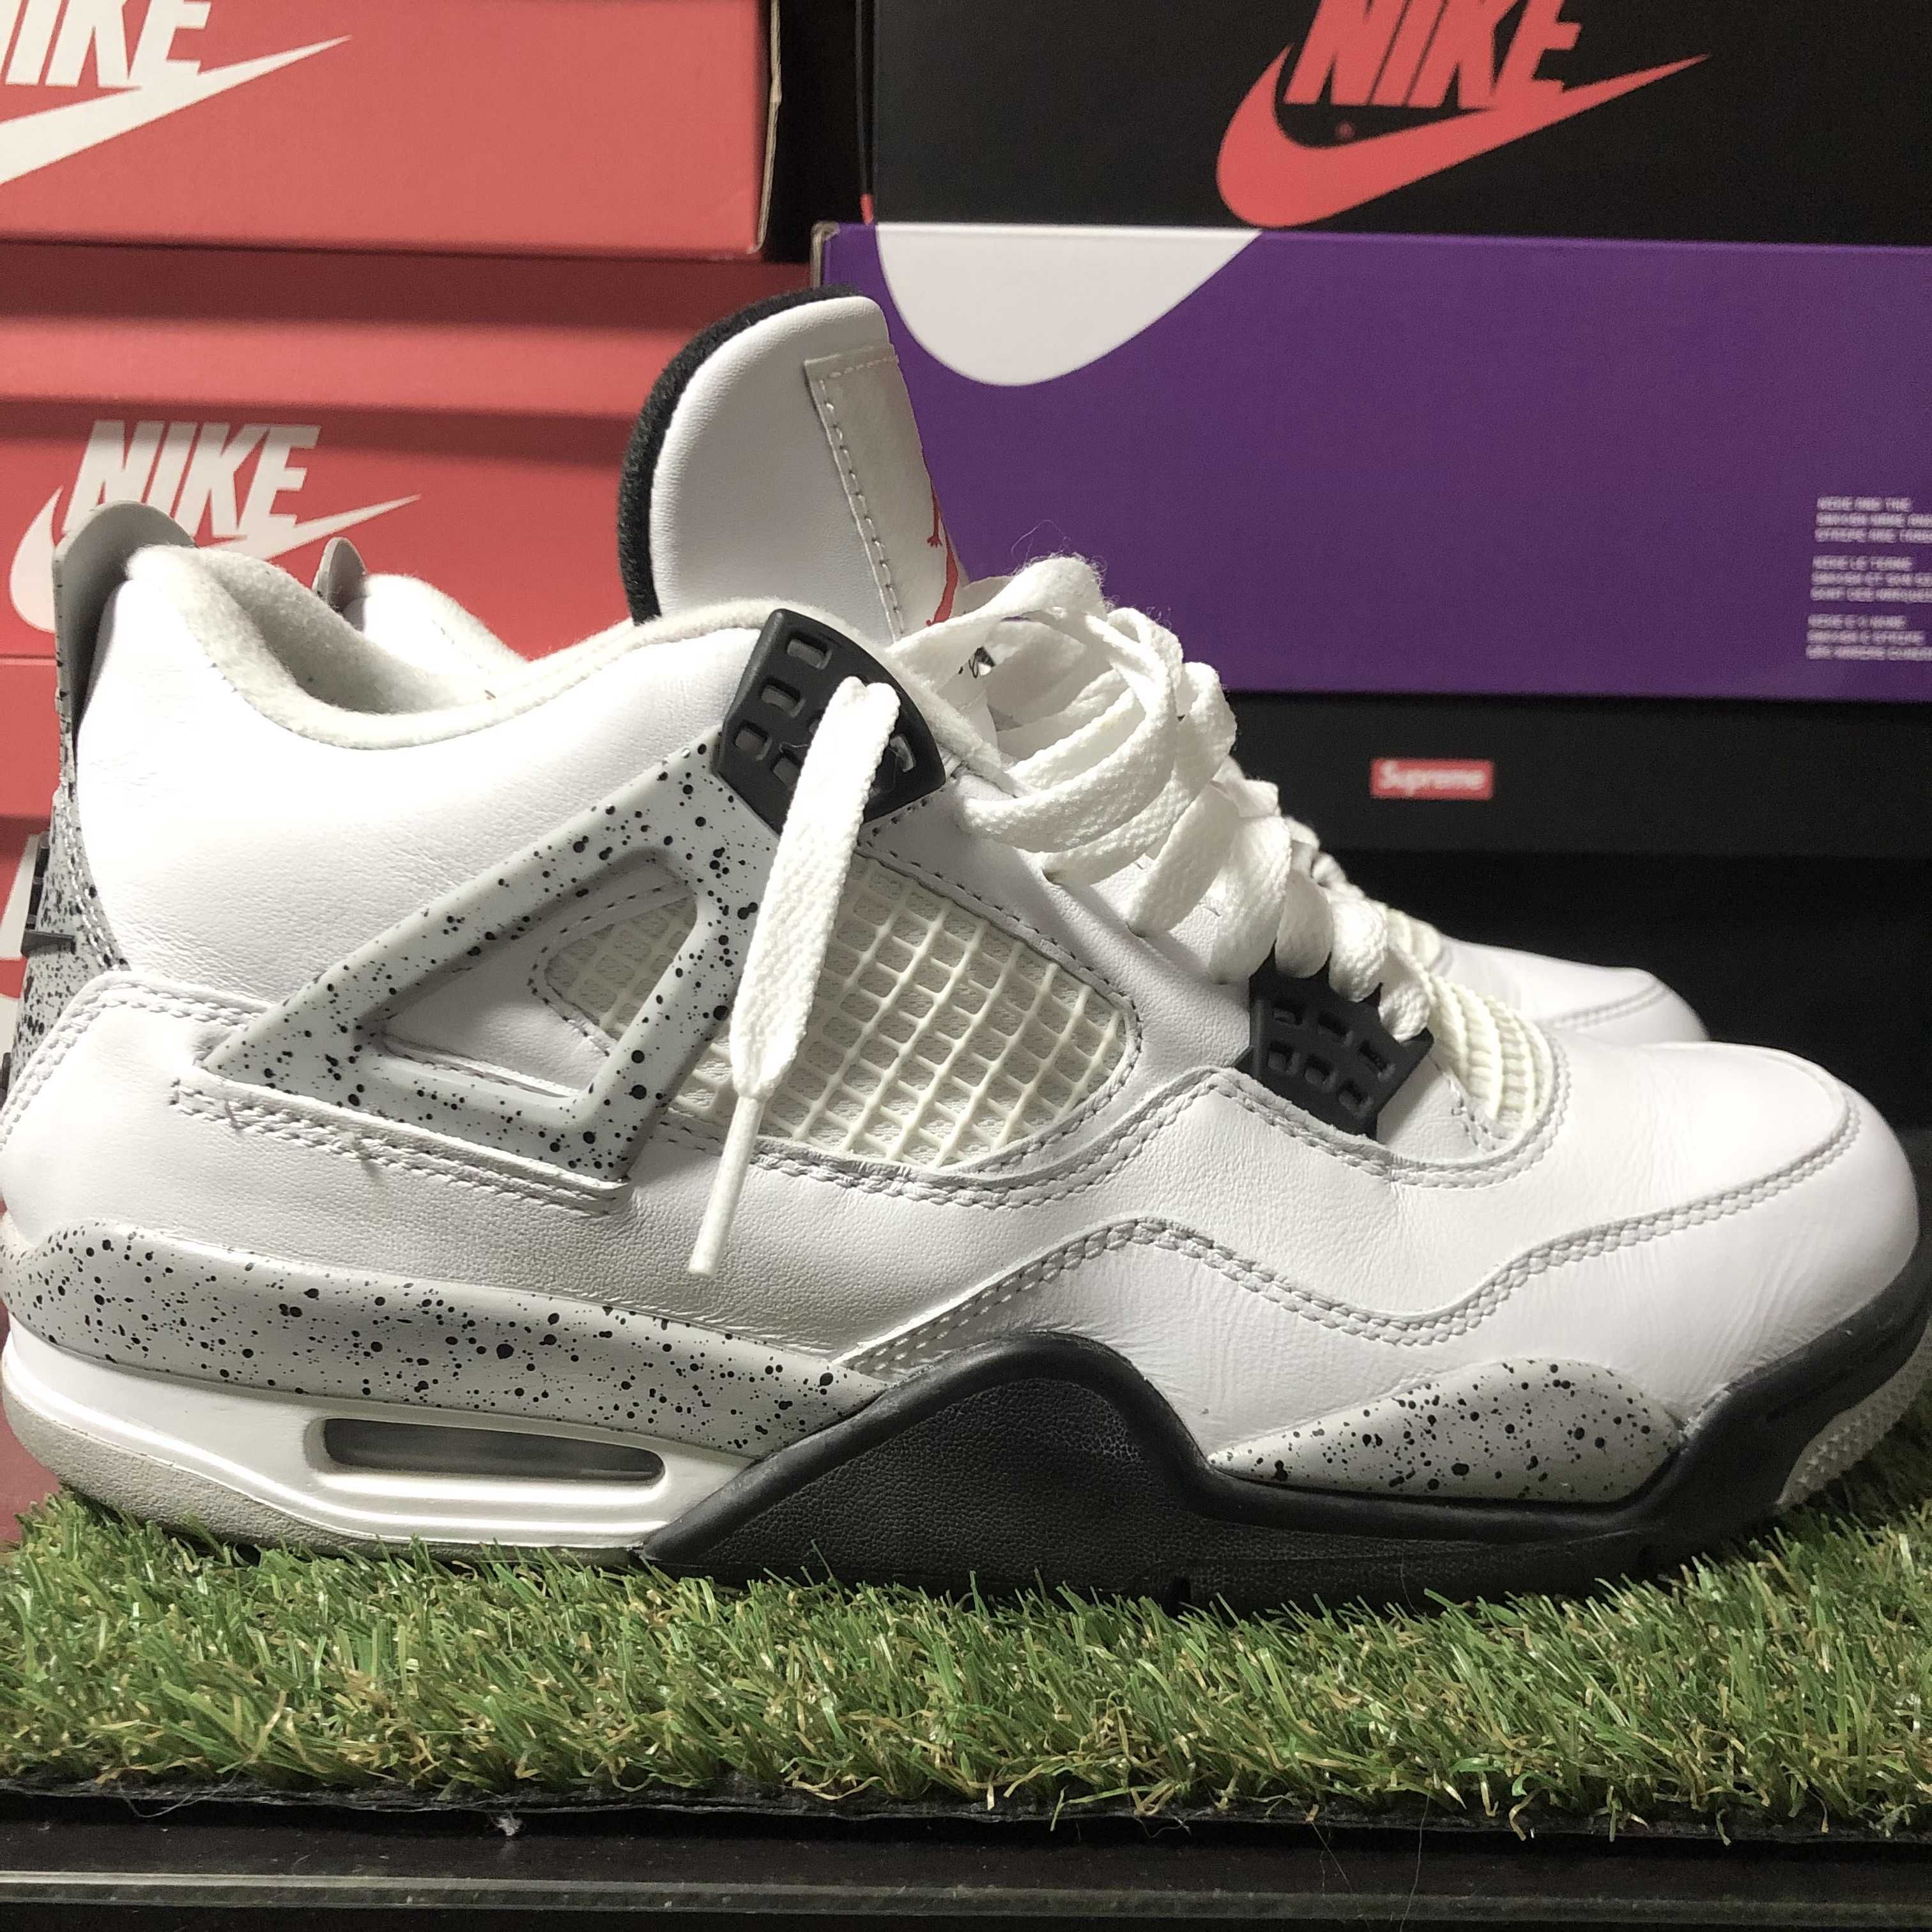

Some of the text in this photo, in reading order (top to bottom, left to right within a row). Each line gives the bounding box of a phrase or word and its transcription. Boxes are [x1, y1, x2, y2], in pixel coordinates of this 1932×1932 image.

[0, 0, 211, 88] IKE
[1284, 0, 1581, 109] NIKE
[62, 419, 321, 538] NIKE
[1378, 760, 1485, 796] Supreme
